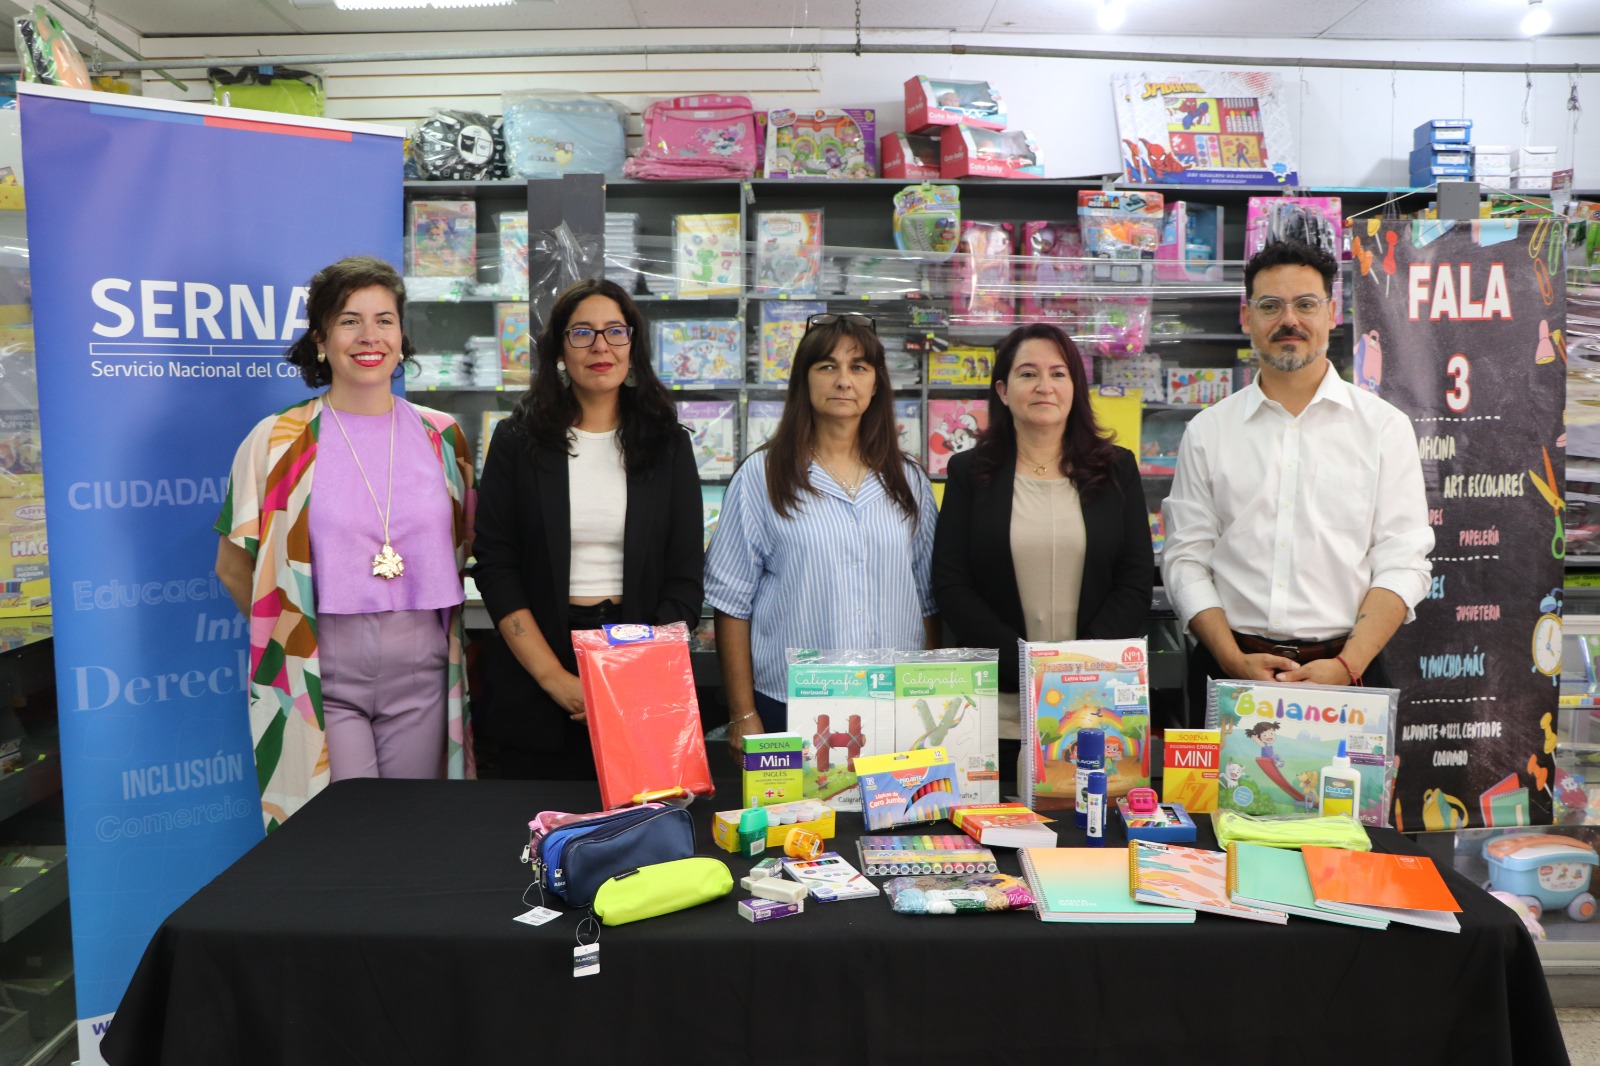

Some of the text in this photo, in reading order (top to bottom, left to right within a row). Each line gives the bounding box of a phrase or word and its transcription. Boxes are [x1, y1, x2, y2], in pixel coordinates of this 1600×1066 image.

[1408, 262, 1513, 320] FALA
[91, 277, 310, 340] SERNA
[91, 361, 301, 378] Servicio Nacional del Co
[1446, 353, 1470, 412] 3
[1419, 435, 1456, 461] OFICINA
[1459, 525, 1500, 546] PAPELERÍA
[195, 611, 251, 643] Inf
[1420, 645, 1486, 678] Y MUCHO MÁS
[1064, 674, 1079, 682] Letra
[1234, 691, 1366, 726] Balancín
[1462, 722, 1491, 740] CENTRO
[1491, 721, 1502, 738] DE
[759, 742, 790, 750] SOPENA
[760, 755, 790, 767] Mini
[1174, 750, 1212, 767] MINI
[122, 750, 244, 800] INCLUSIÓN
[837, 796, 862, 805] Caligraf
[869, 796, 907, 808] Cera Jumbo
[96, 796, 250, 842] Comercio
